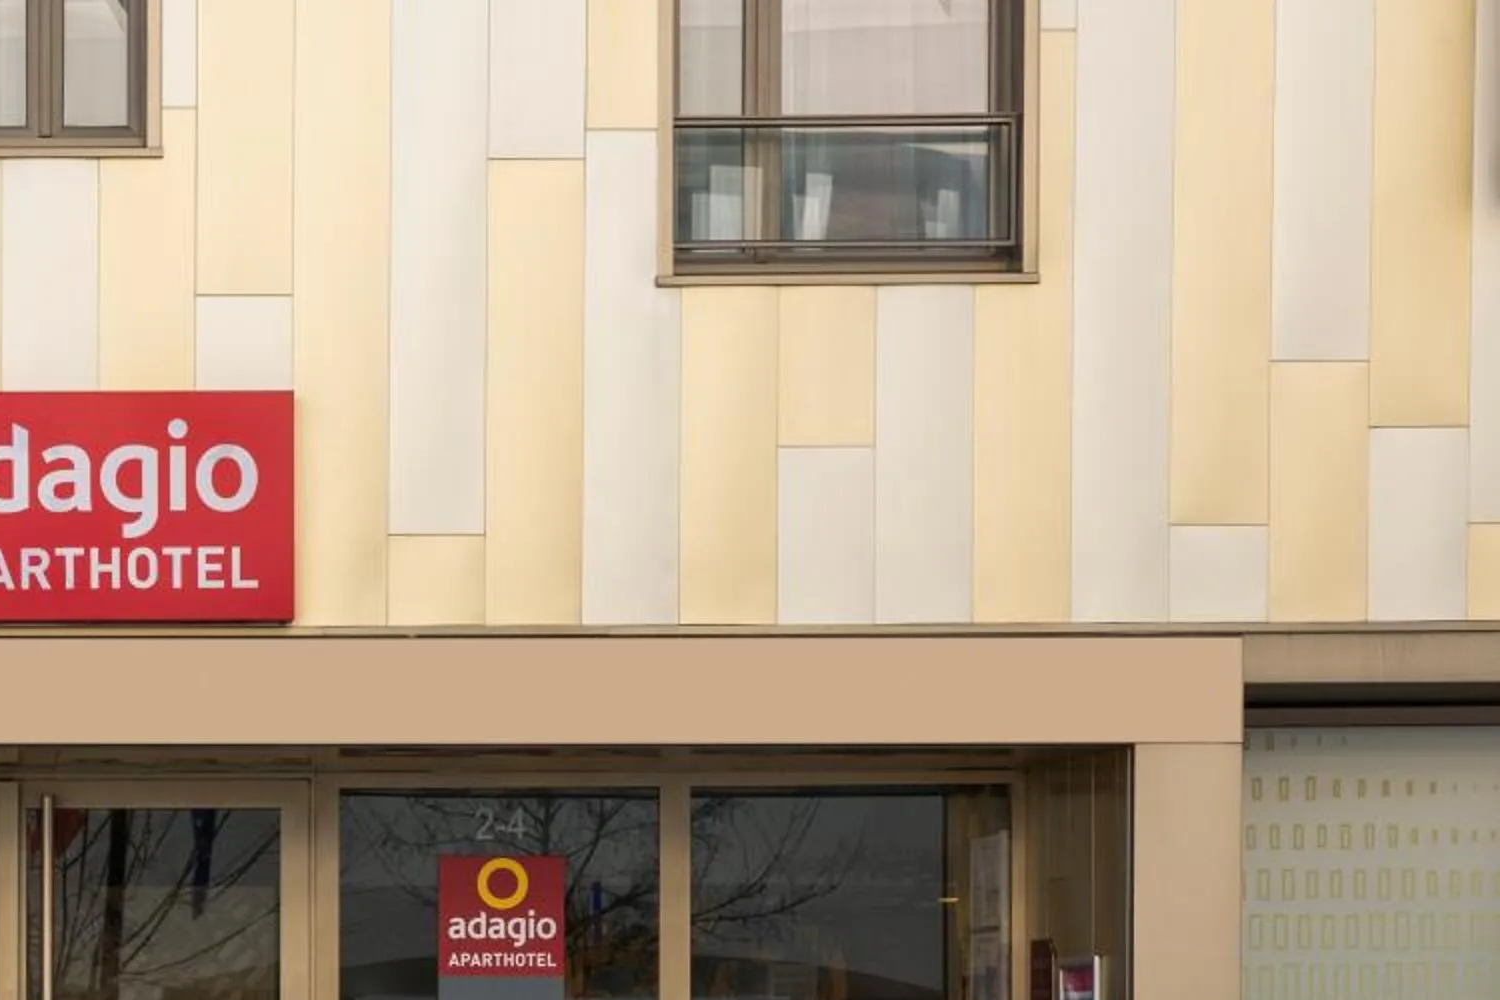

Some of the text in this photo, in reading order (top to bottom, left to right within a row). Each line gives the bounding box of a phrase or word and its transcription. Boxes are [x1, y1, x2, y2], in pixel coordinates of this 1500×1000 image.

[474, 807, 528, 840] 2-4
[448, 910, 557, 947] adagio
[449, 952, 557, 967] APARTHOTEL
